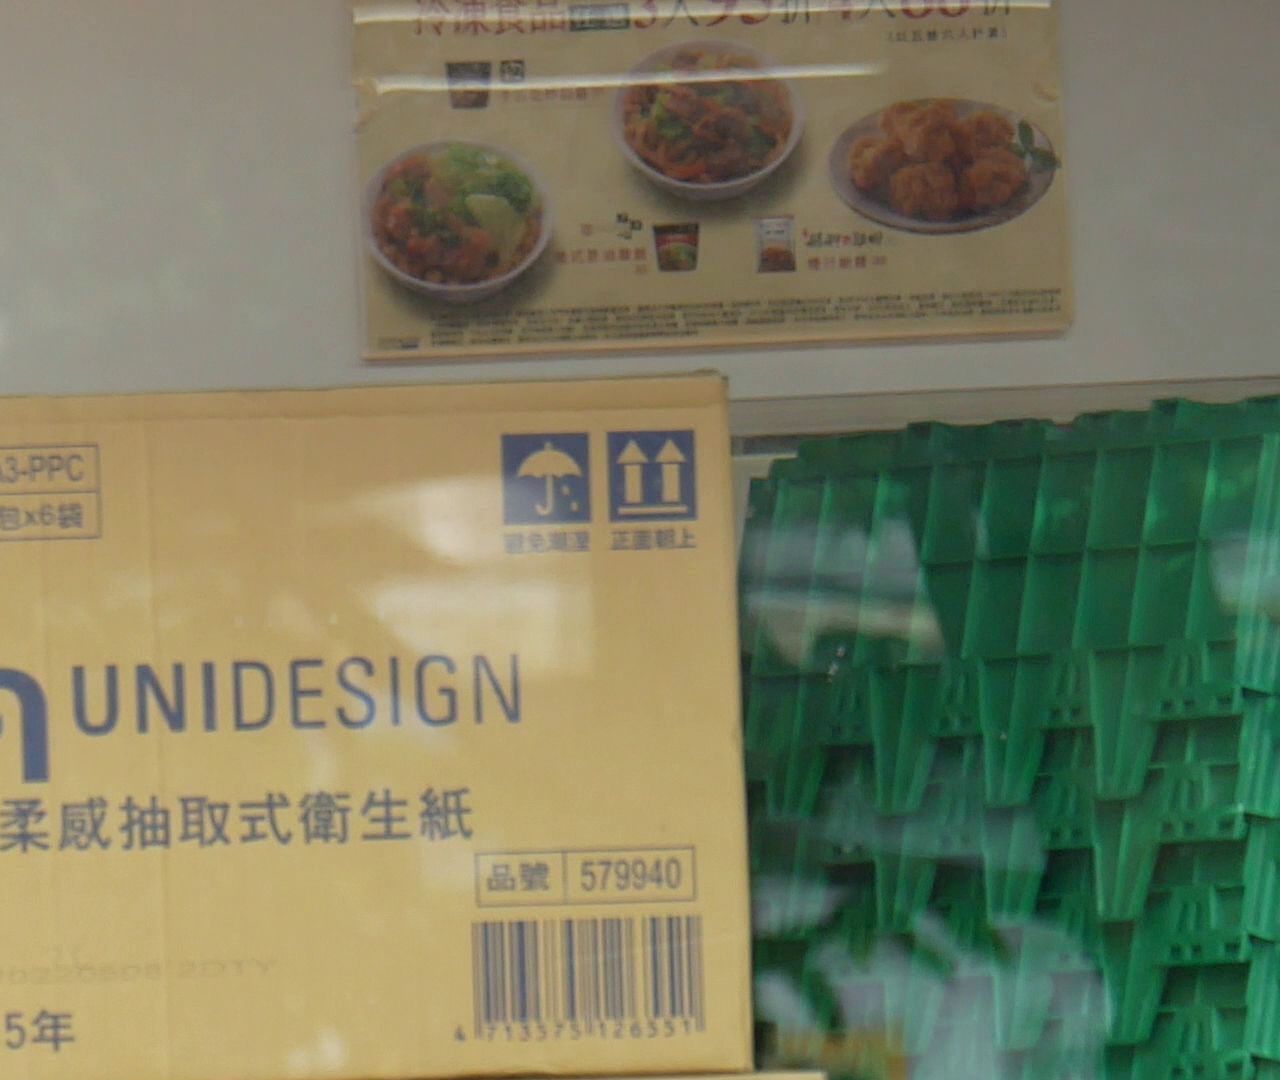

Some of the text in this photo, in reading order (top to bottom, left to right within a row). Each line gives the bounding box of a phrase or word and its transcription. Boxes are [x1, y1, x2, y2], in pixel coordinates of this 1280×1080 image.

[72, 654, 522, 735] UNIDESIGN
[487, 858, 682, 891] 品號 579940
